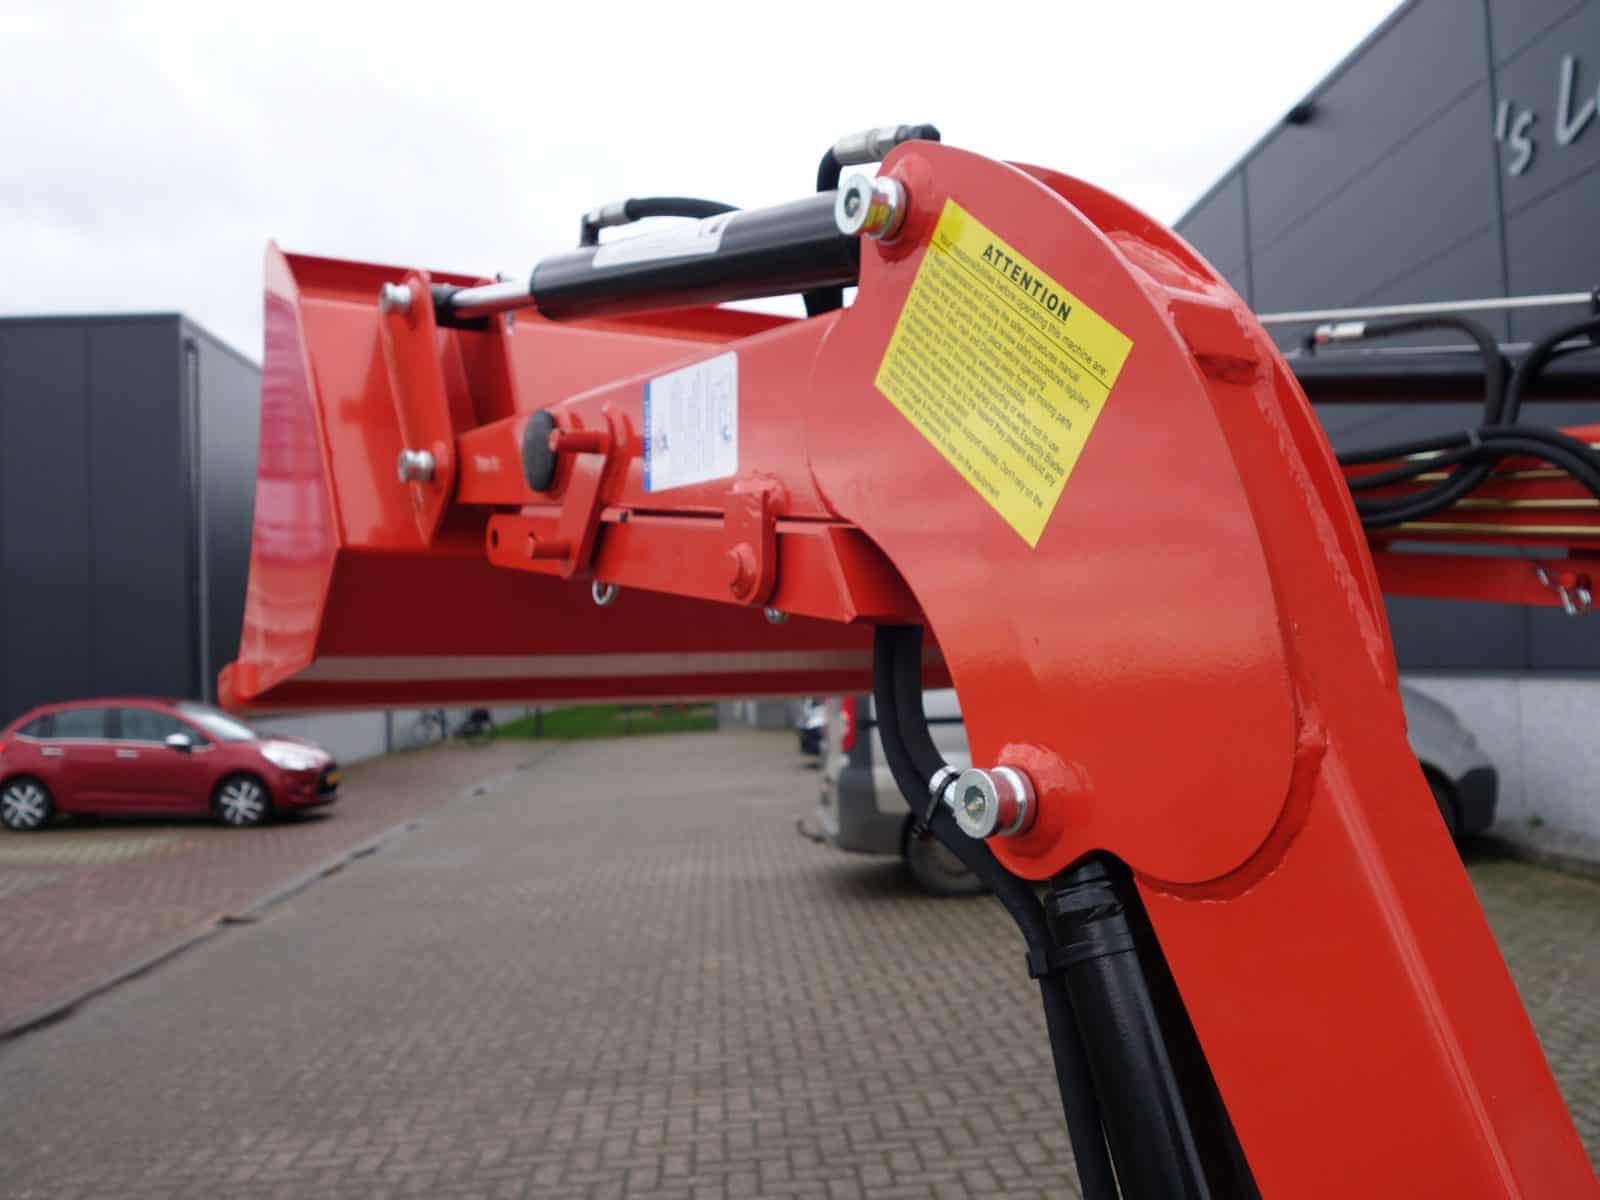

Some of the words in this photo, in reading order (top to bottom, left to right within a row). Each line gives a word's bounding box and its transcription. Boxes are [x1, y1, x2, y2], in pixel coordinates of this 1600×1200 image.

[982, 241, 1072, 322] ATTENTION
[995, 279, 1017, 302] before
[1014, 296, 1048, 330] operating
[1047, 321, 1062, 339] this
[1060, 333, 1093, 365] machine
